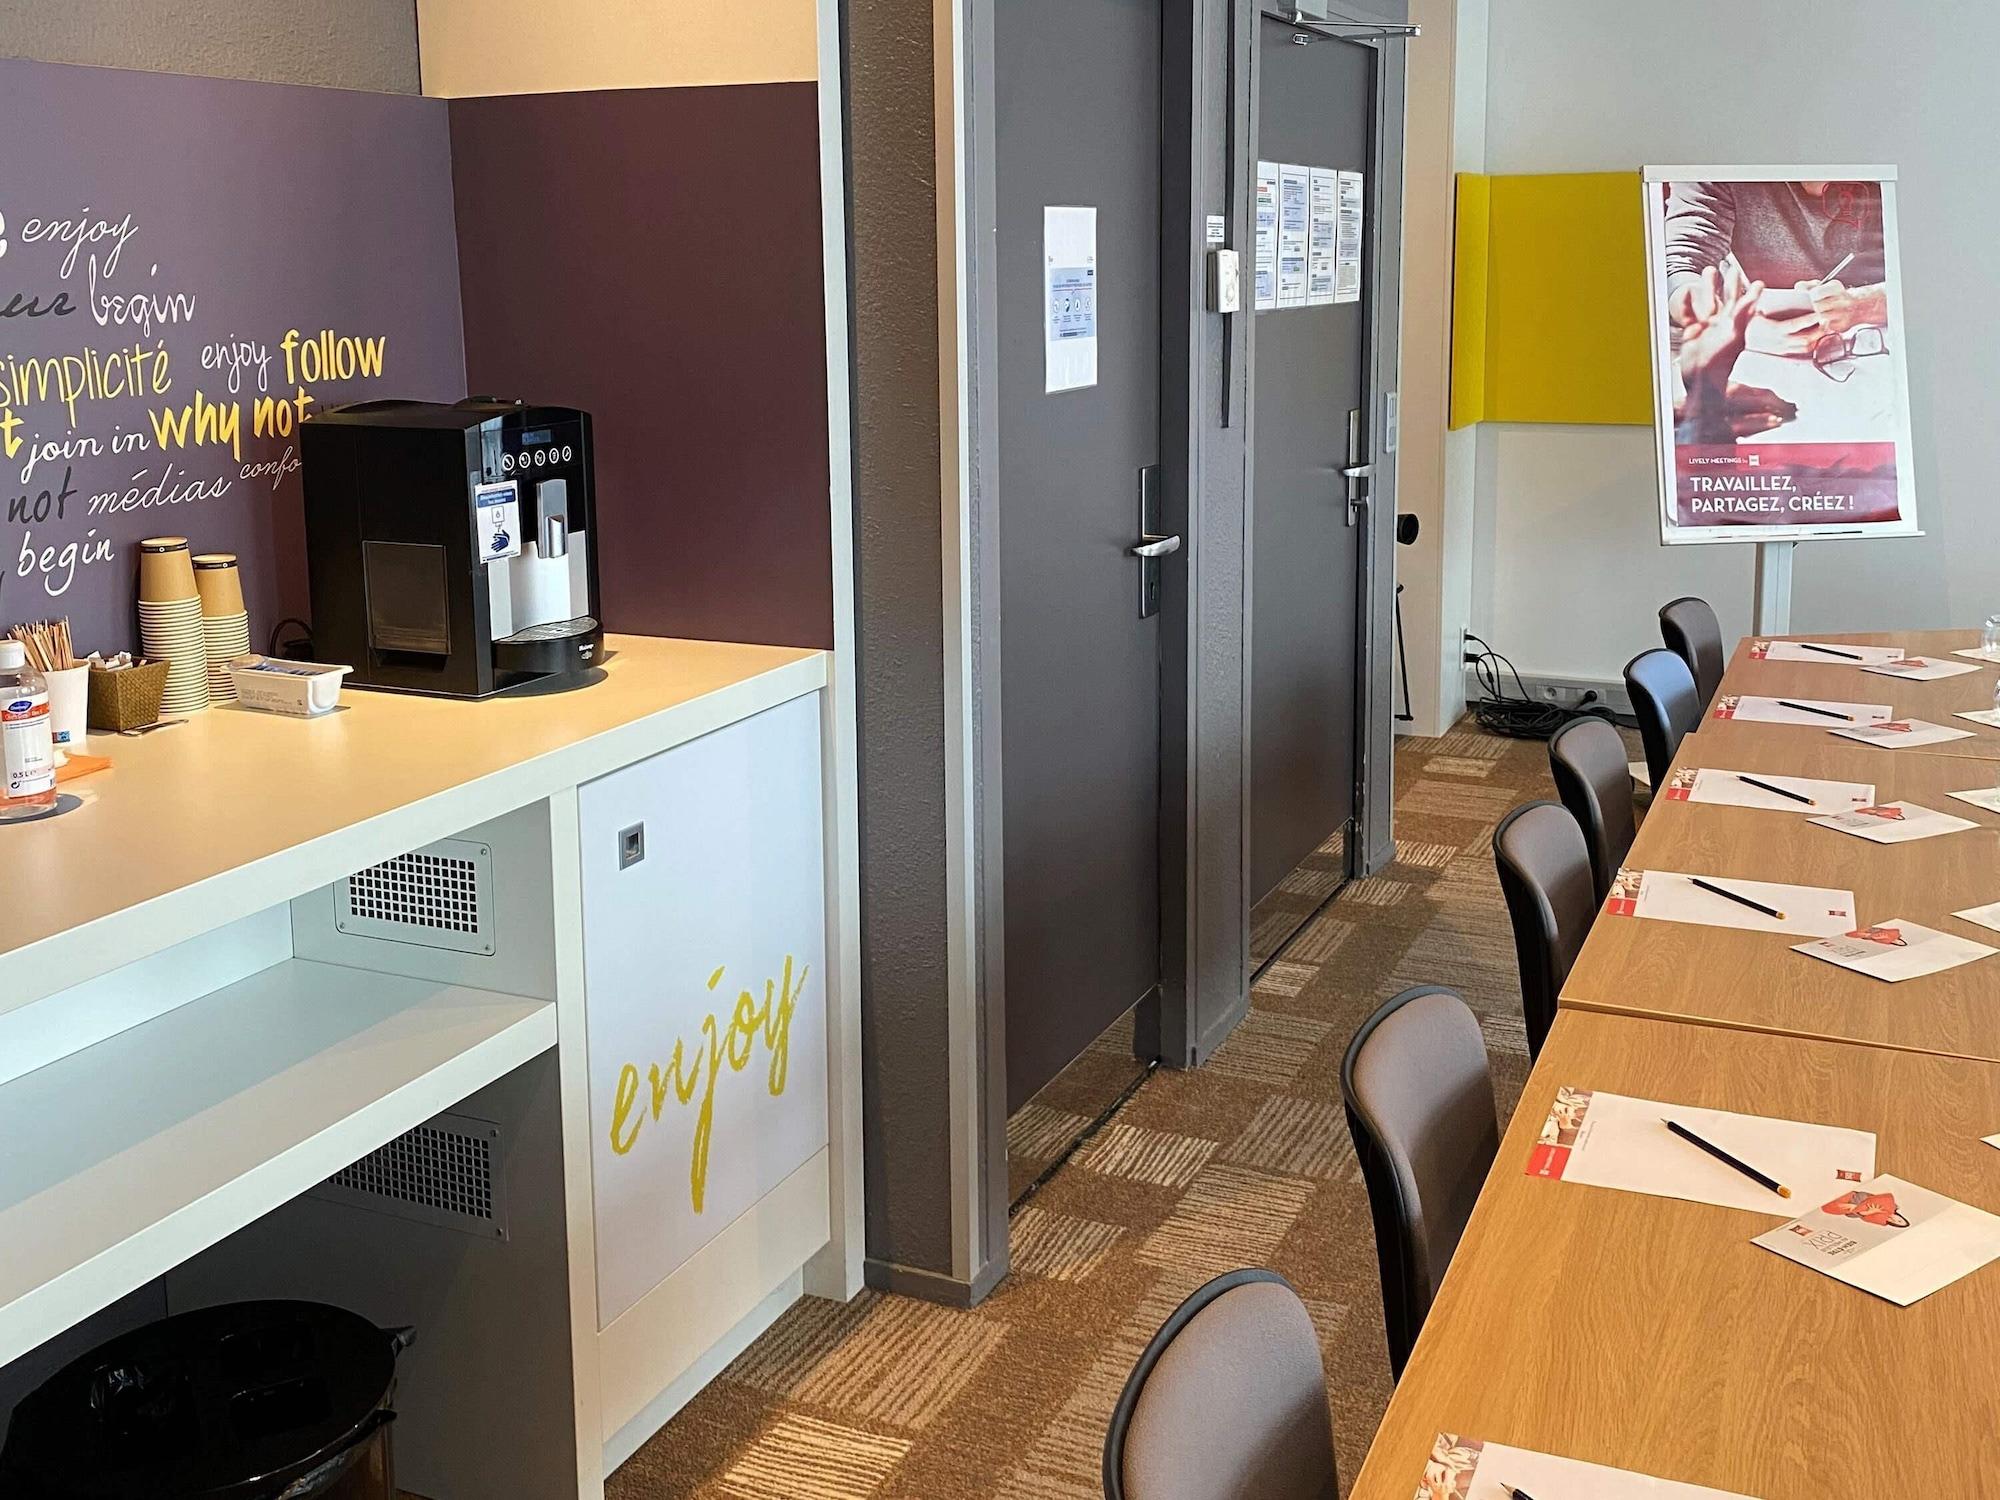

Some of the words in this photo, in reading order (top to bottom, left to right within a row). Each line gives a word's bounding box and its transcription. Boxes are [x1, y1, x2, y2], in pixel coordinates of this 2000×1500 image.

[21, 207, 139, 279] enjoy
[88, 254, 196, 337] begin
[201, 333, 272, 393] enjoy
[280, 329, 387, 385] follow
[21, 432, 104, 484] join
[112, 426, 150, 454] in
[148, 390, 241, 463] why
[253, 385, 315, 438] not
[1688, 457, 1710, 465] LIVELY
[8, 466, 78, 523] not
[87, 462, 232, 517] médias
[1690, 475, 1797, 493] TRAVAILLEZ,
[1691, 497, 1785, 514] PARTAGEZ,
[1789, 491, 1845, 511] CRÉEZ
[17, 529, 115, 597] begin
[610, 954, 810, 1215] enjoy
